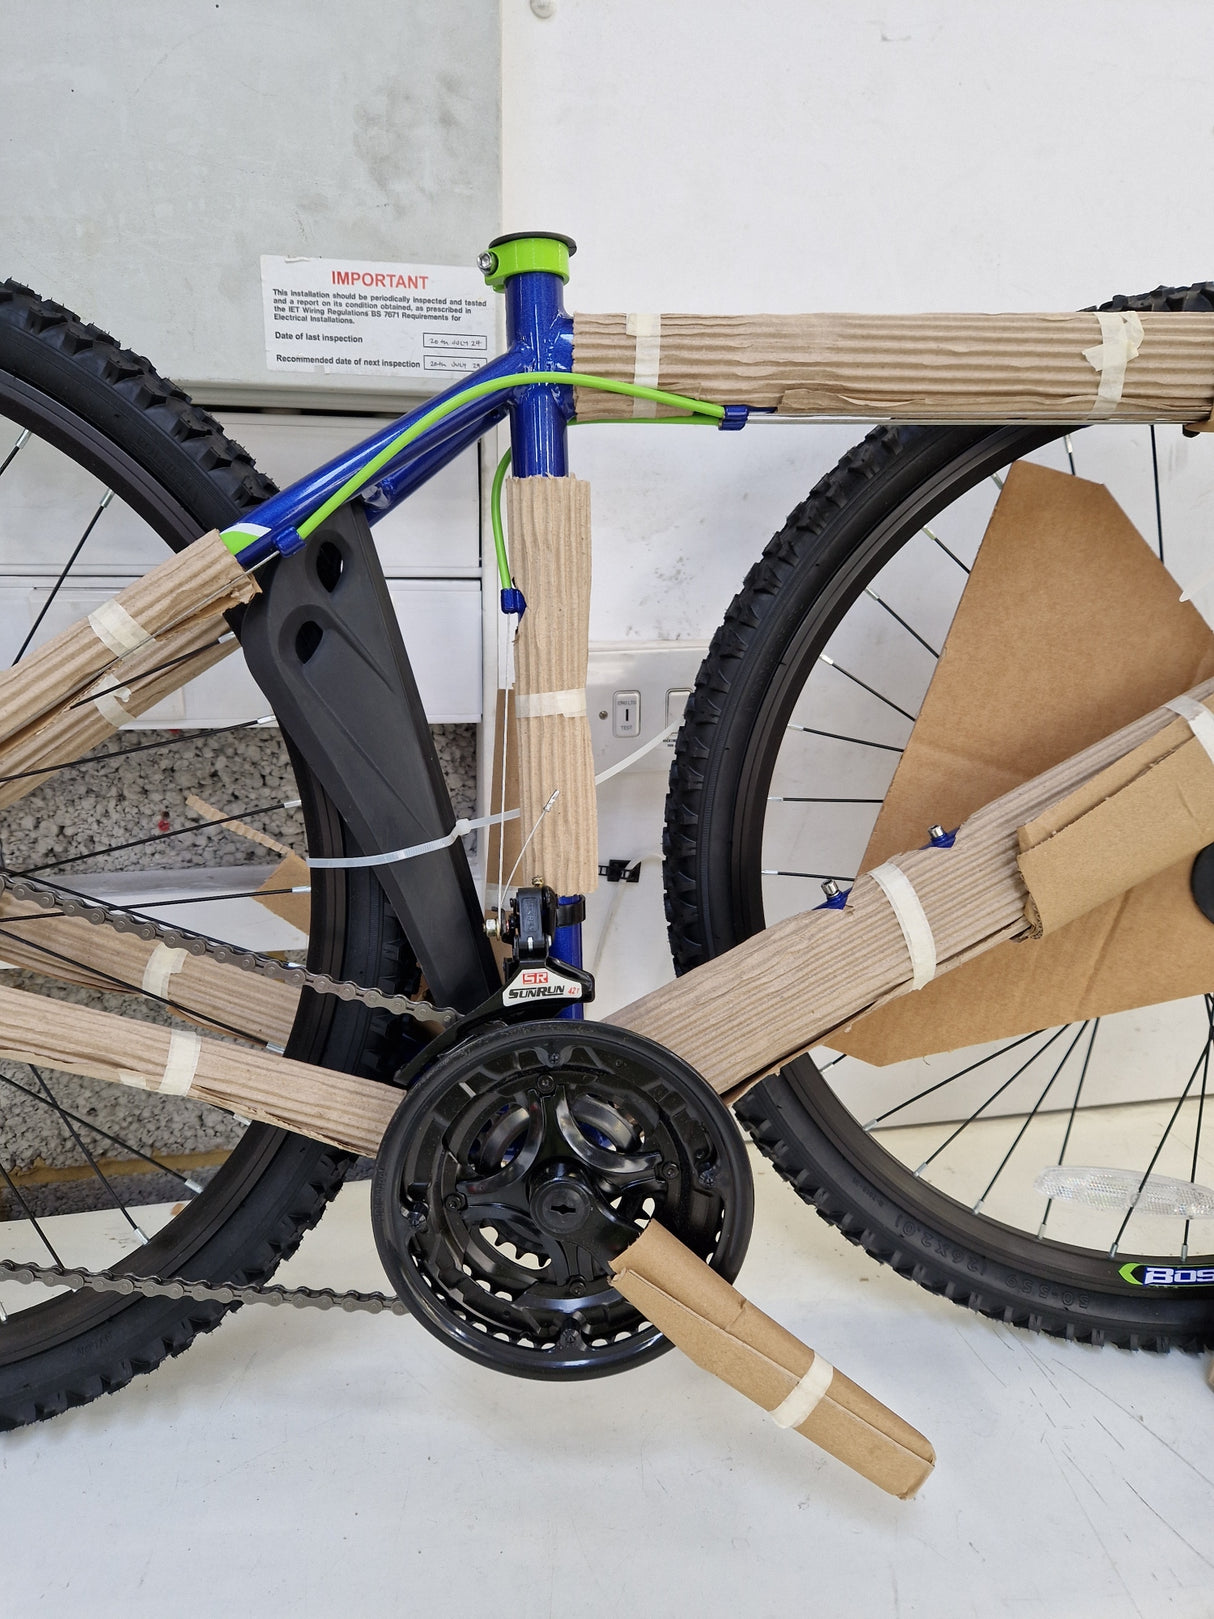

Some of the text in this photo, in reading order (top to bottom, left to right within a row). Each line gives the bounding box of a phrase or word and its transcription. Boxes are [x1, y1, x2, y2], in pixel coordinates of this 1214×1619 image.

[331, 270, 429, 290] IMPORTANT
[272, 288, 487, 307] This installation should be periodically inspected and tested
[273, 297, 287, 305] and
[297, 299, 319, 307] report
[333, 300, 343, 308] its
[345, 301, 378, 309] condition
[380, 302, 413, 312] obtained,
[426, 305, 463, 314] prescribed
[464, 306, 472, 314] in
[273, 305, 286, 313] the
[302, 306, 325, 316] Wiring
[327, 307, 369, 317] Regulations
[371, 310, 382, 318] BS
[401, 311, 449, 321] Requirements
[451, 314, 462, 322] for
[273, 313, 355, 325] Electrical Installations.
[275, 331, 363, 343] Date of last inspection
[276, 354, 421, 369] Recommended date of next inspection
[523, 972, 548, 985] SR
[1004, 1273, 1091, 1310] 50-559
